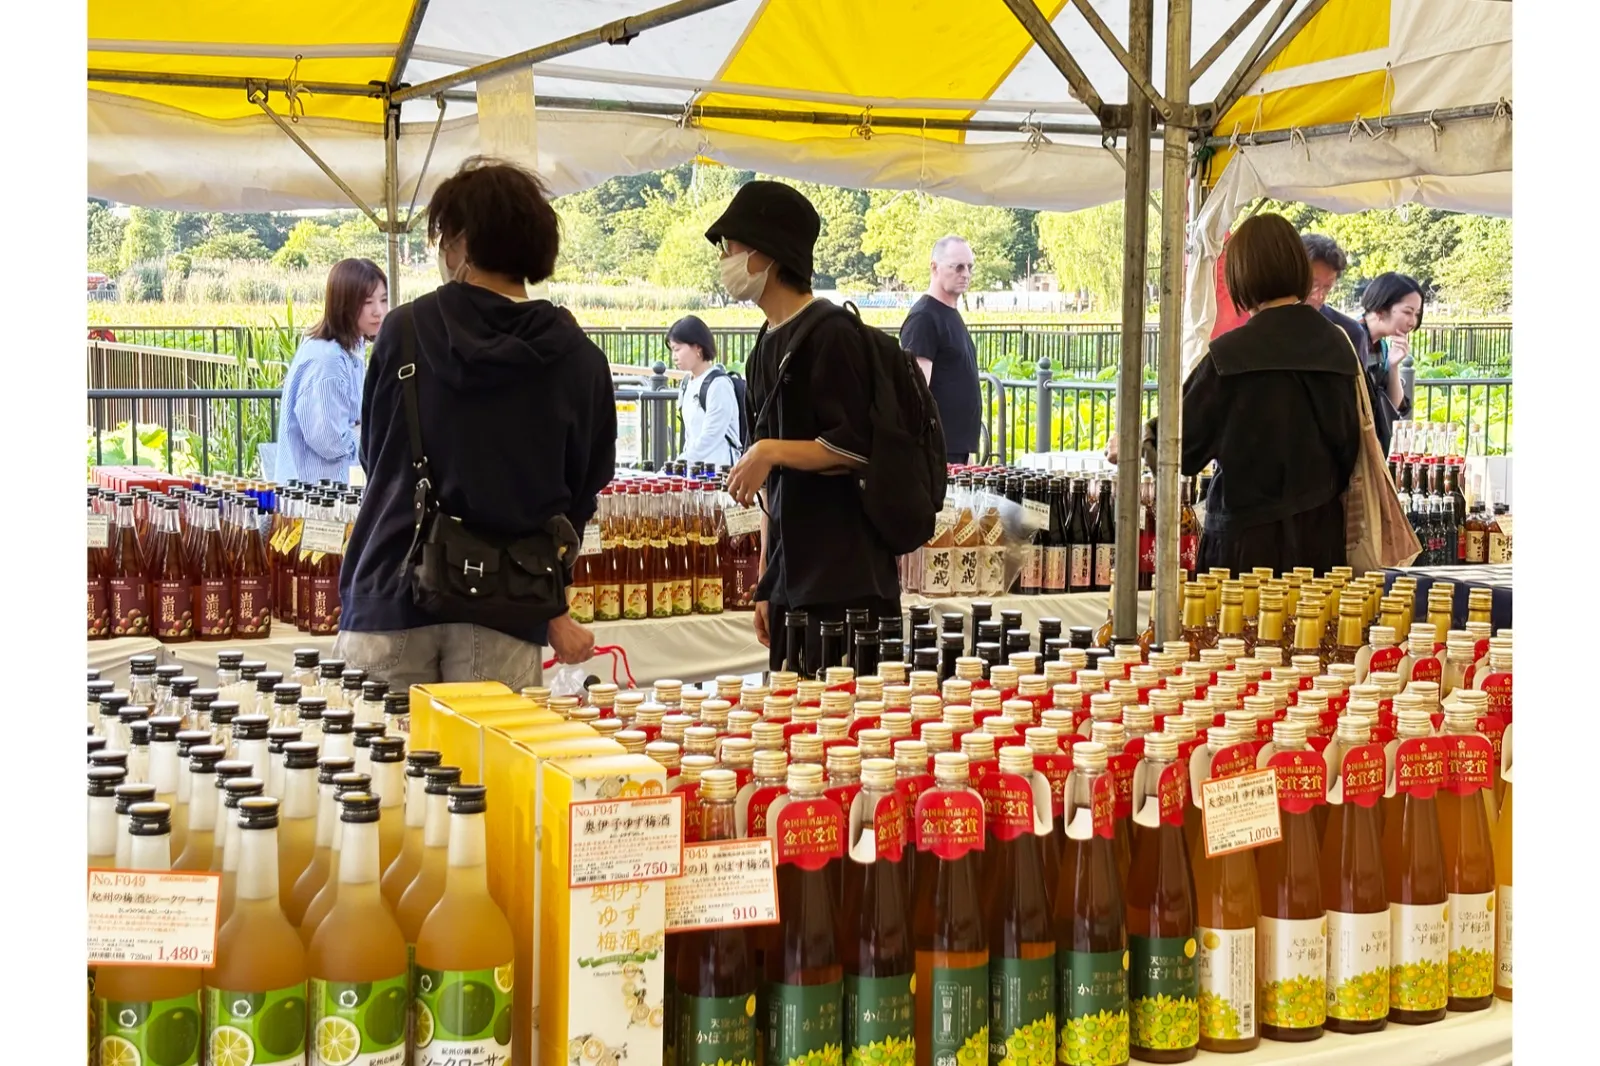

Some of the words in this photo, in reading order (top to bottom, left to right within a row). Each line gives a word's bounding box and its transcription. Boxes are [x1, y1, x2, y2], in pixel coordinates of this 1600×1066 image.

[1400, 760, 1444, 778] 金賞受賞
[1448, 760, 1487, 774] 賞受賞
[1346, 768, 1383, 787] 金賞受賞
[984, 798, 1029, 817] 金賞受賞
[1208, 792, 1239, 808] 天空の月
[575, 804, 619, 817] No.F047
[922, 817, 978, 834] 金賞受賞
[784, 826, 838, 845] 金賞受賞
[1249, 827, 1272, 842] 1,070
[632, 861, 668, 878] 2,750
[714, 858, 770, 872] かぼす梅酒
[92, 874, 146, 888] No.F049
[598, 903, 641, 928] ゆず
[732, 906, 757, 920] 910
[596, 929, 641, 952] 梅酒
[158, 946, 199, 962] 1,480
